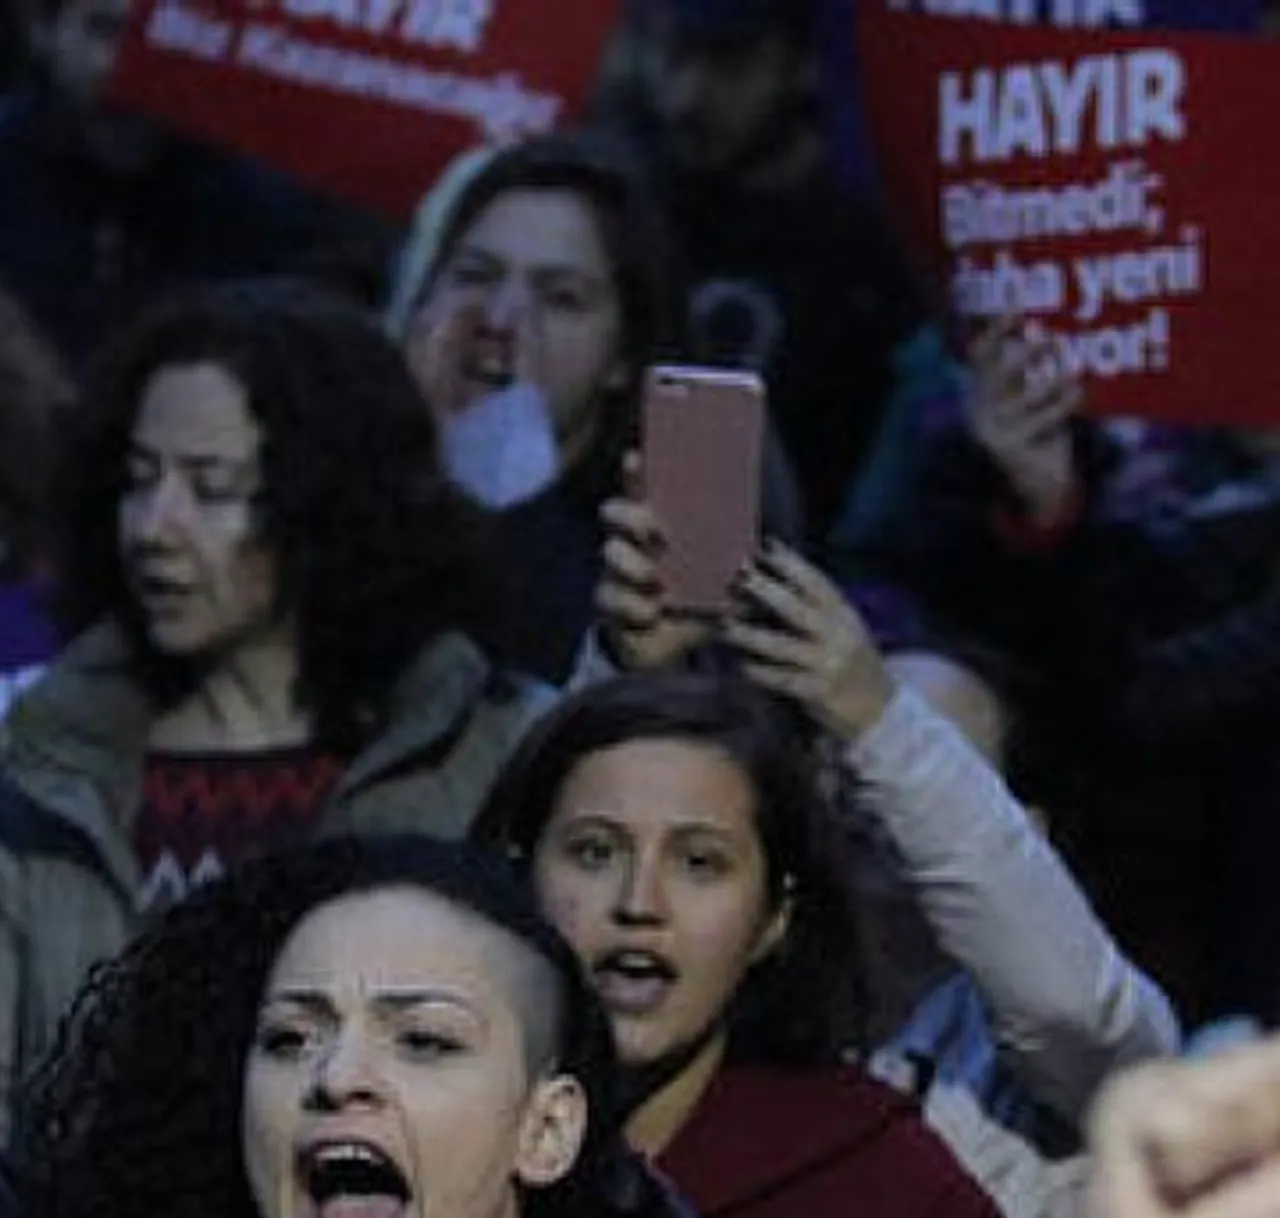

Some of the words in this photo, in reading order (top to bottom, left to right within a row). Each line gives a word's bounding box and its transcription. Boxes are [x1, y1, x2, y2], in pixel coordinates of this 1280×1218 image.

[937, 48, 1186, 166] HAYIR
[941, 160, 1167, 249] Bitmedi;
[1074, 222, 1202, 321] yeni
